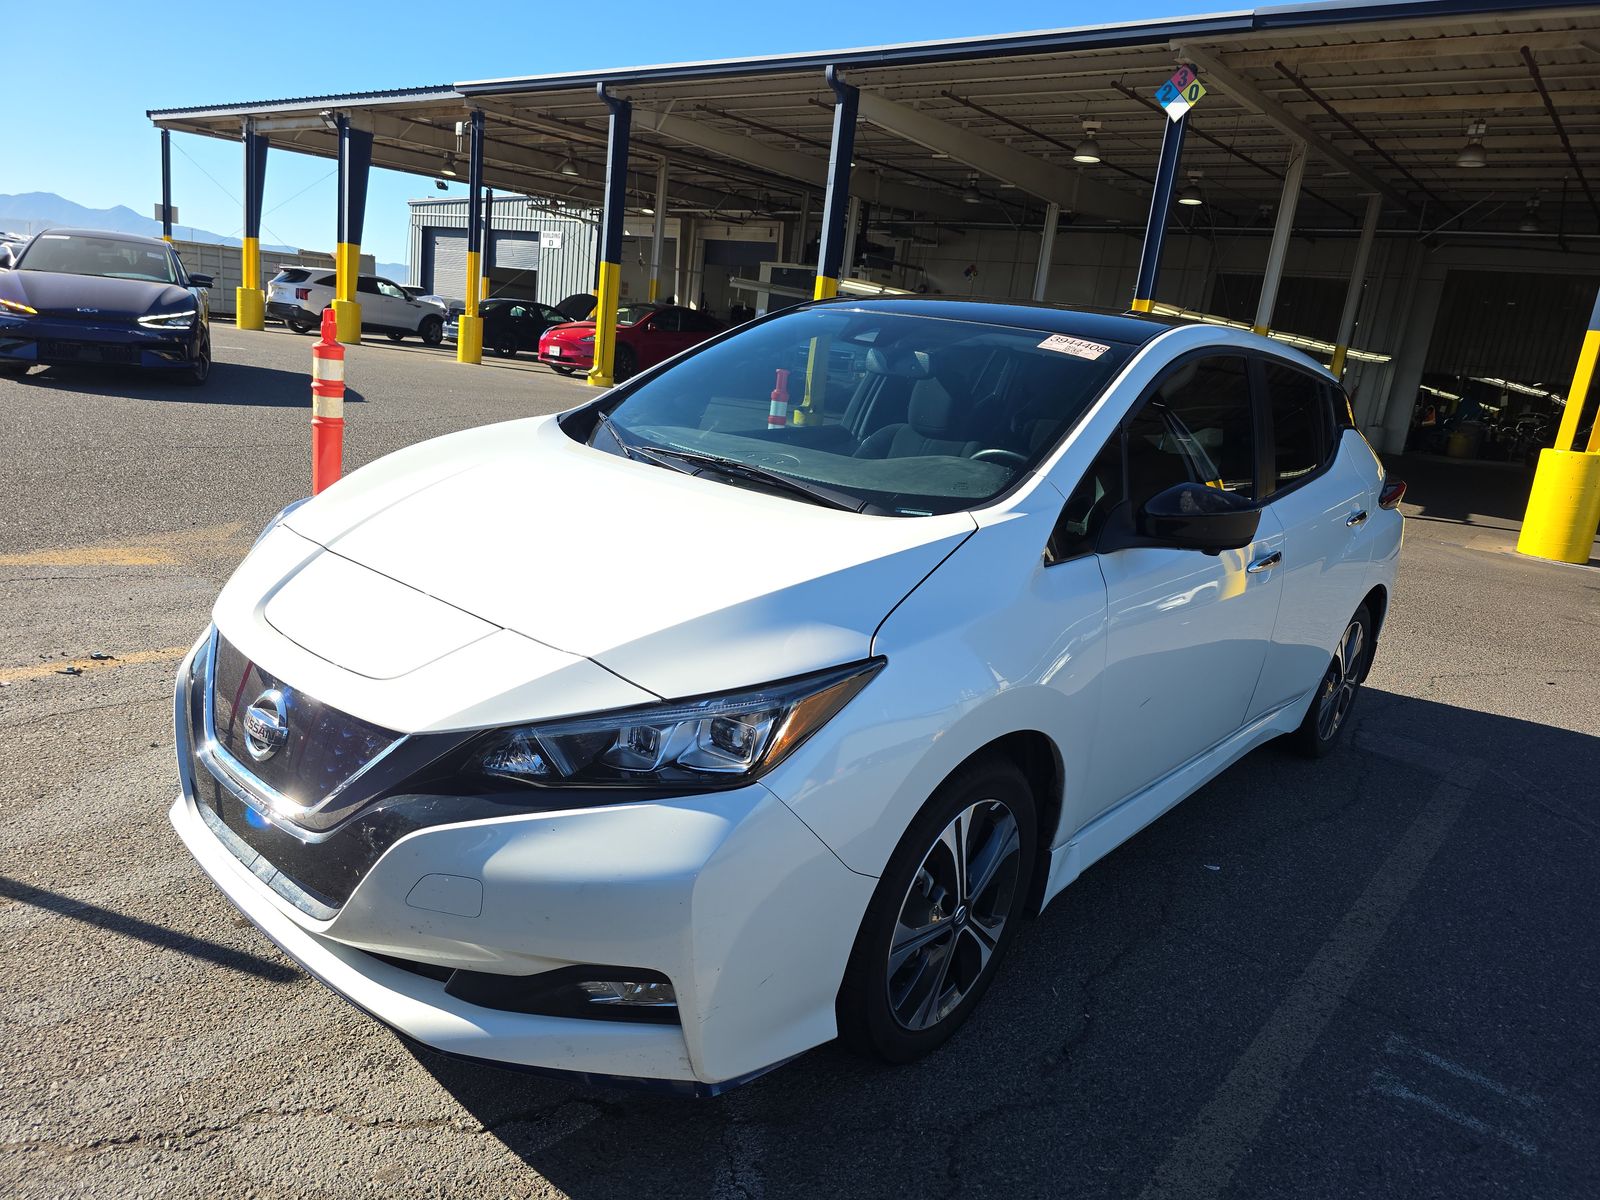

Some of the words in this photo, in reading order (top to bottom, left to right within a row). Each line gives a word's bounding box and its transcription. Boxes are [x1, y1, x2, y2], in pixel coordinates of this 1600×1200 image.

[1178, 69, 1188, 87] 3
[1161, 84, 1172, 101] 2
[1188, 84, 1199, 101] 0
[548, 239, 554, 247] D
[1050, 335, 1107, 353] 3944408
[245, 717, 276, 743] ISSAN
